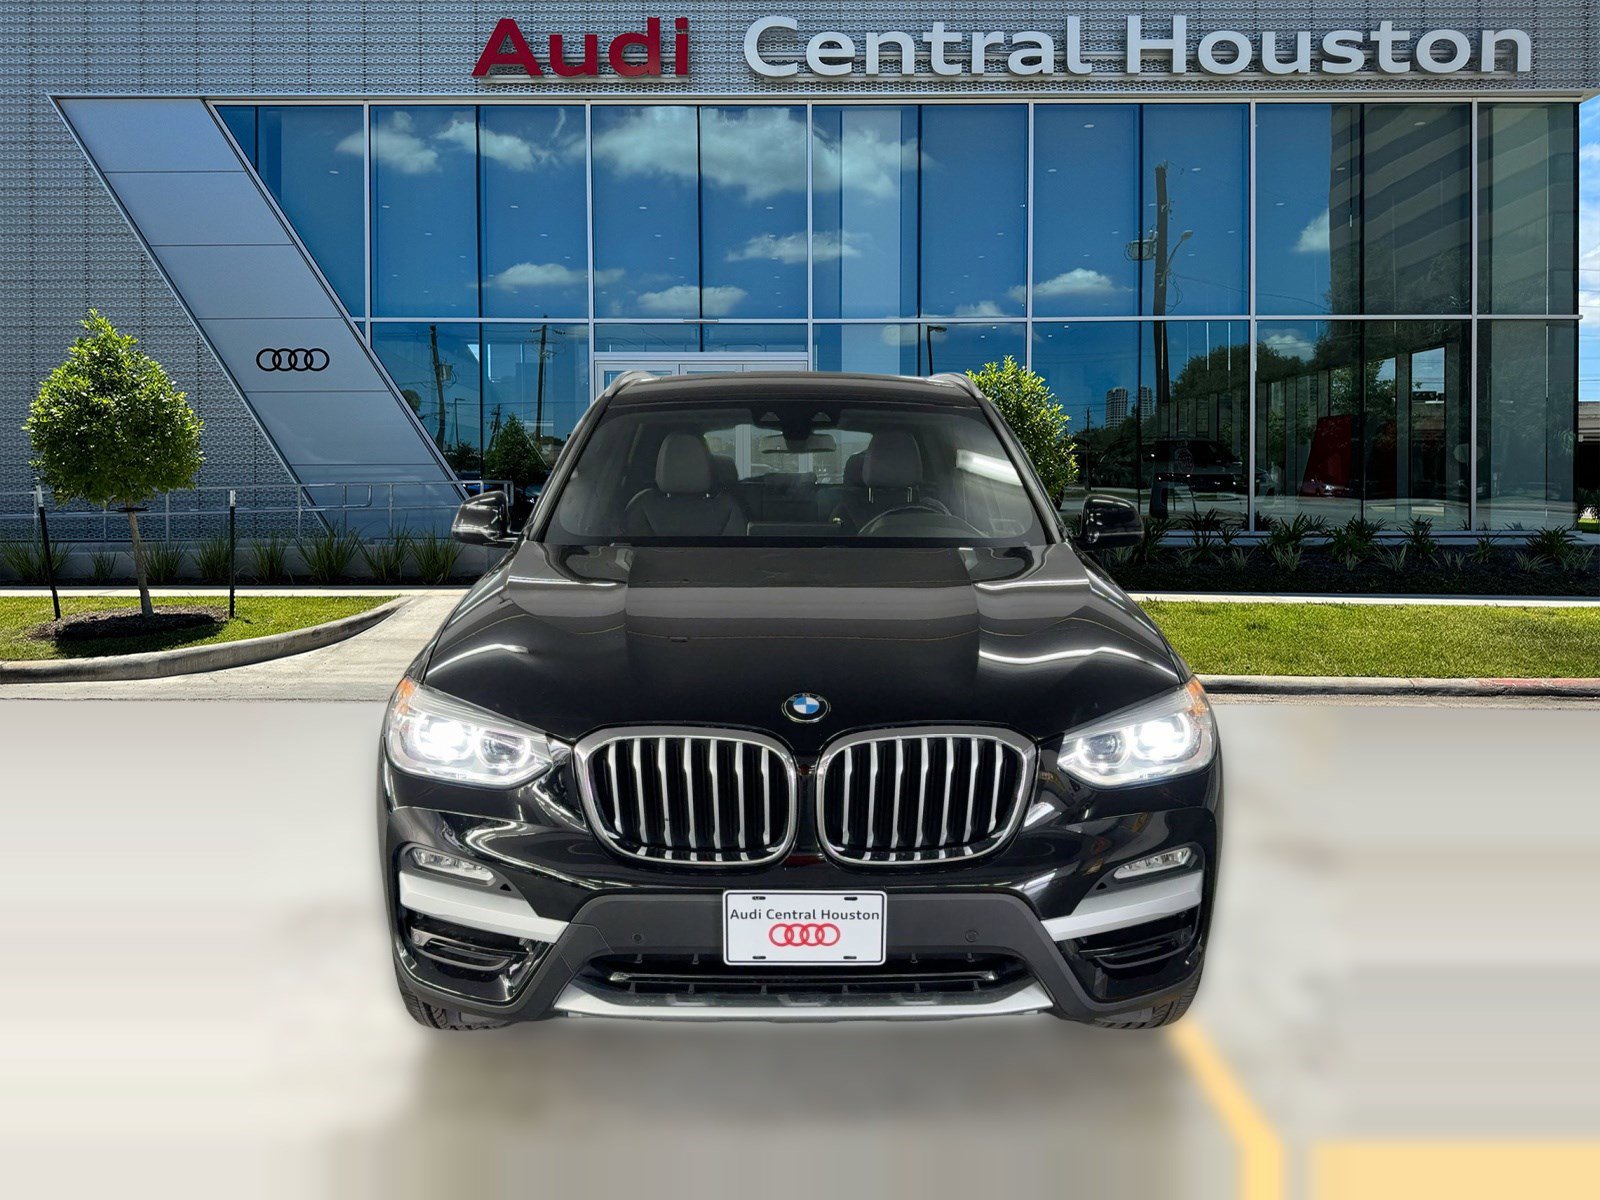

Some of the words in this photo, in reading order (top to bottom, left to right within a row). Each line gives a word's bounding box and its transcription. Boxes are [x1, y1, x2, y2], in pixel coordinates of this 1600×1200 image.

[472, 16, 690, 78] Audi
[743, 15, 1093, 78] Central
[1126, 14, 1532, 76] Houston
[730, 908, 762, 920] Audi
[766, 908, 816, 920] Central
[821, 909, 880, 921] Houston
